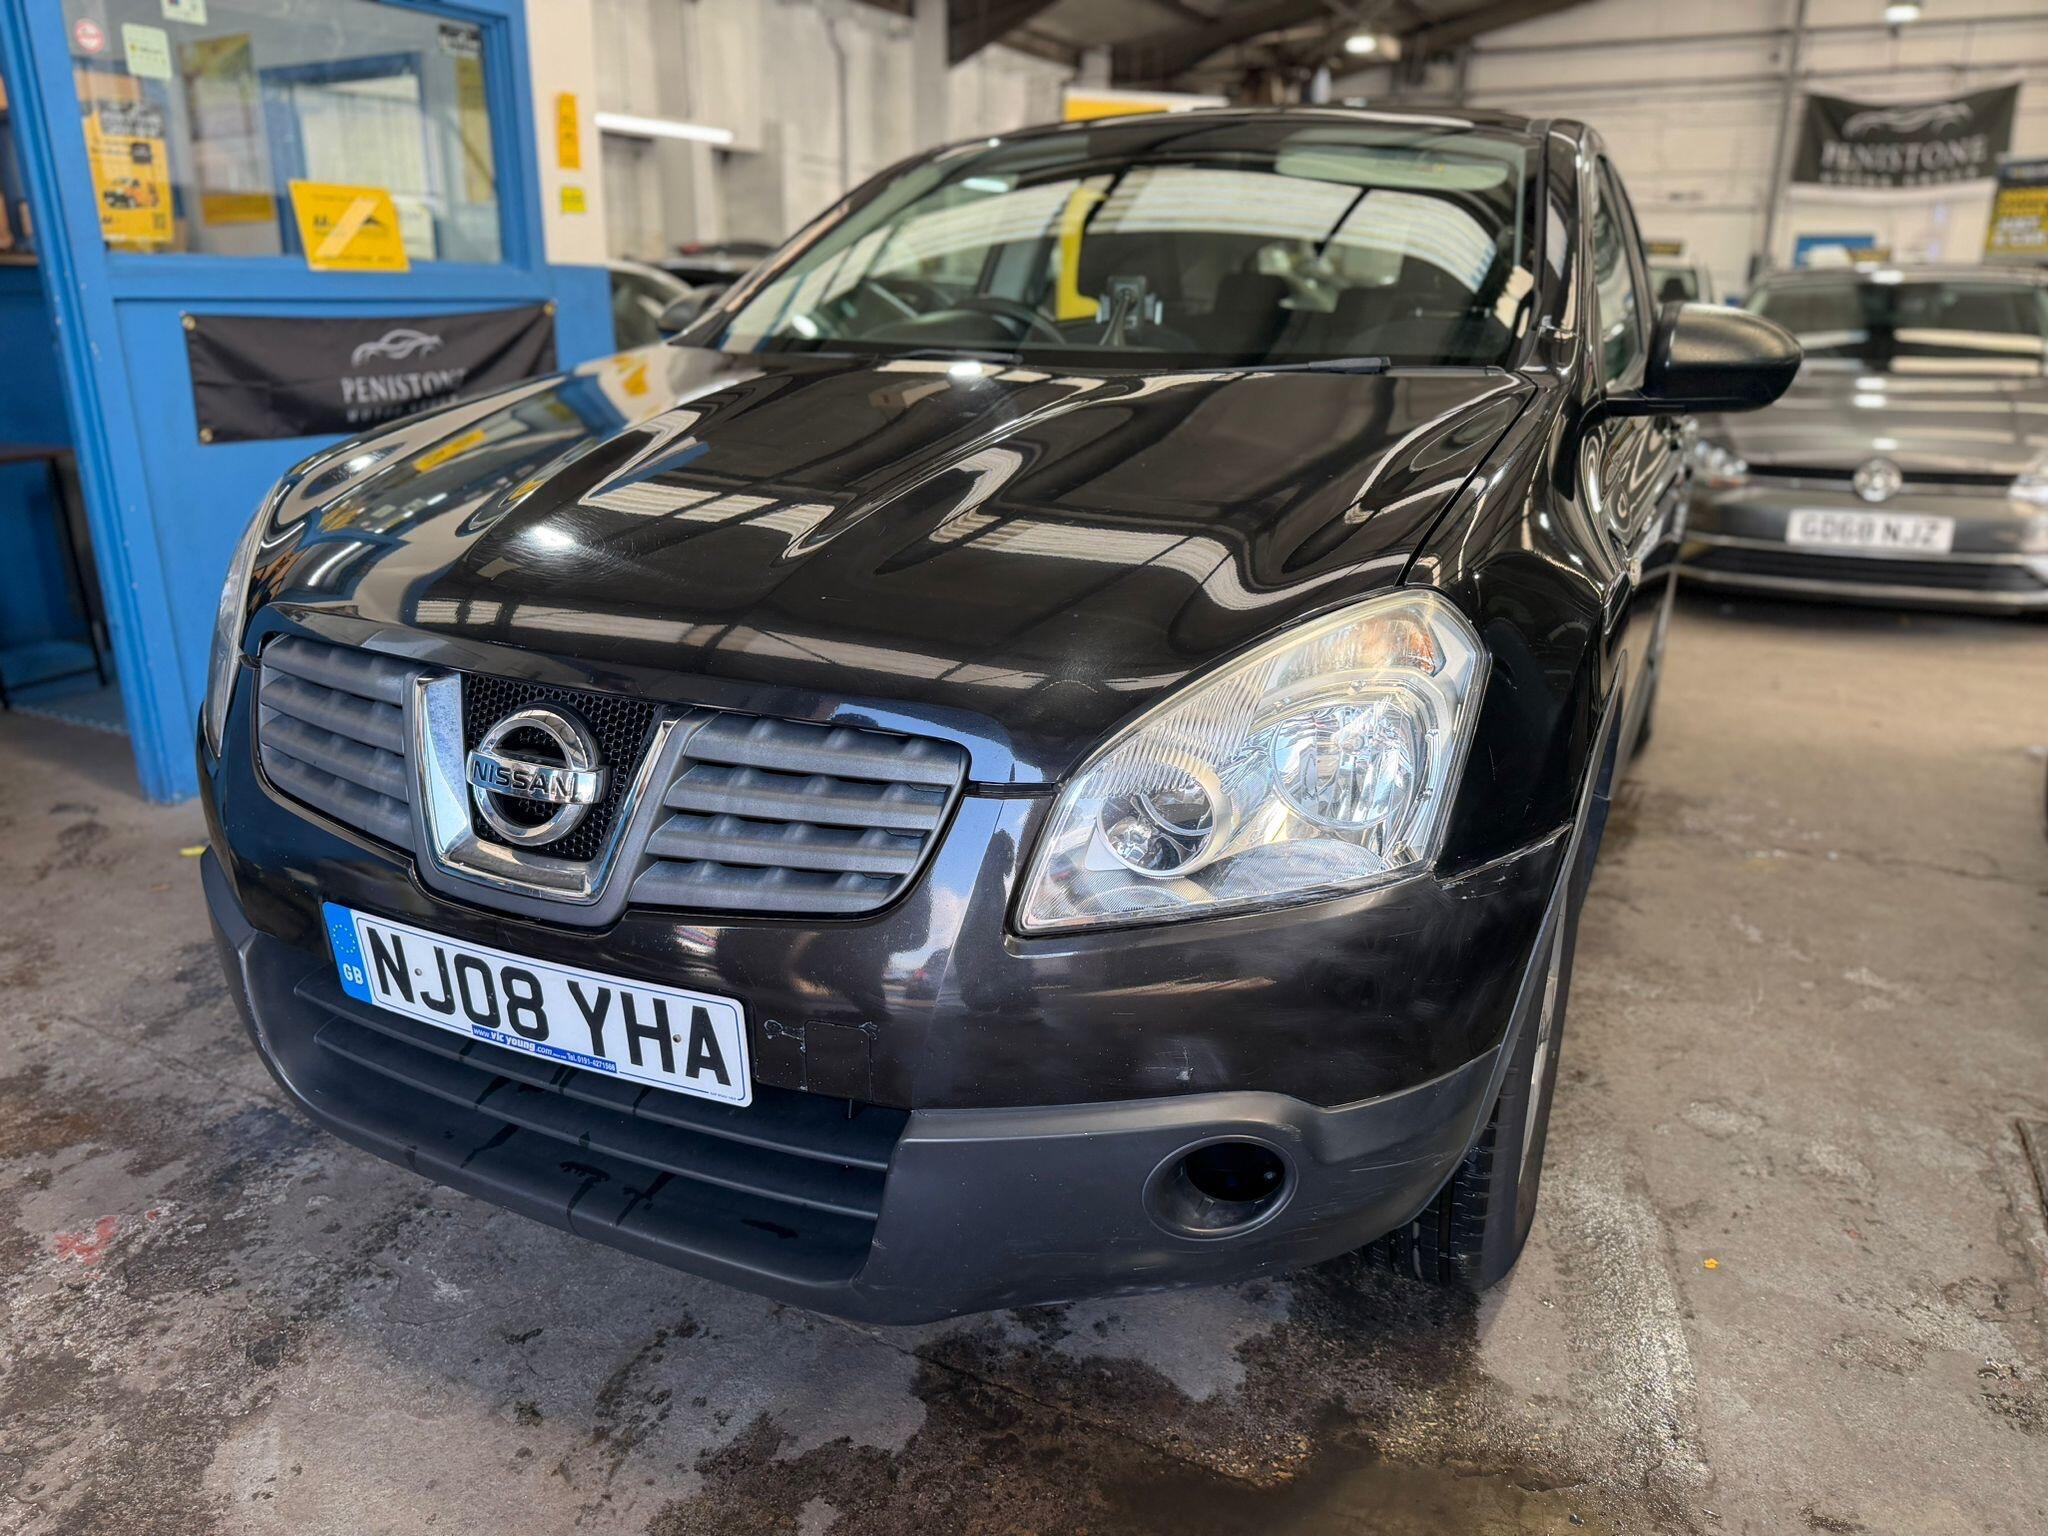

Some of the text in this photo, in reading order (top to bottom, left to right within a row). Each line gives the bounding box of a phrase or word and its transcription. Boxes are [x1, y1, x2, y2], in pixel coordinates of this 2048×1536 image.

[473, 759, 576, 800] NISSAN
[342, 962, 364, 985] GB
[366, 926, 732, 1087] NJ08 YHA
